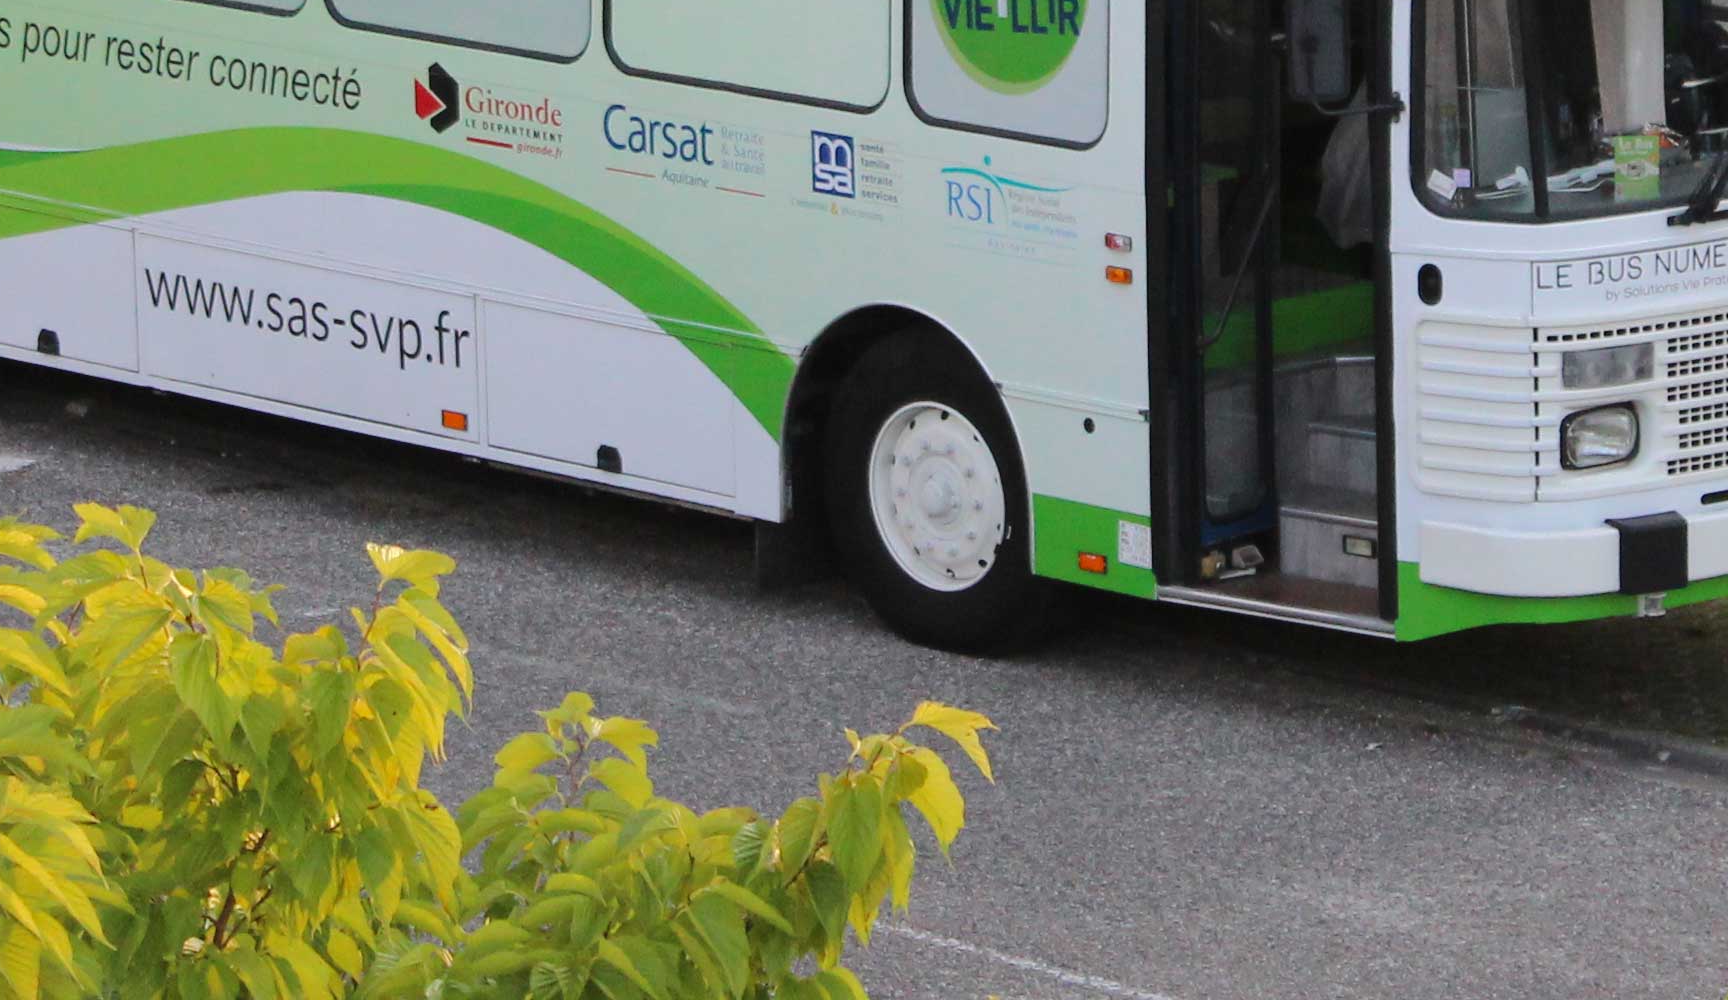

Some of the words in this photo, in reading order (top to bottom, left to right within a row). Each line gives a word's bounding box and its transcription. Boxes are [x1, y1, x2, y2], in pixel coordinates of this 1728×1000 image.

[22, 21, 96, 63] pour
[105, 35, 199, 81] rester
[209, 55, 362, 110] connecté
[465, 86, 562, 127] Gironde
[465, 118, 476, 128] LE
[482, 121, 564, 143] DEPARTEMENT
[603, 103, 714, 166] Carsat
[946, 180, 993, 225] RSI
[1536, 264, 1573, 290] LE
[1588, 255, 1643, 285] BUS
[1605, 289, 1620, 302] by
[1623, 280, 1680, 298] Solutions
[1682, 278, 1700, 291] Vie
[144, 268, 471, 370] www.sas-svp.fr
